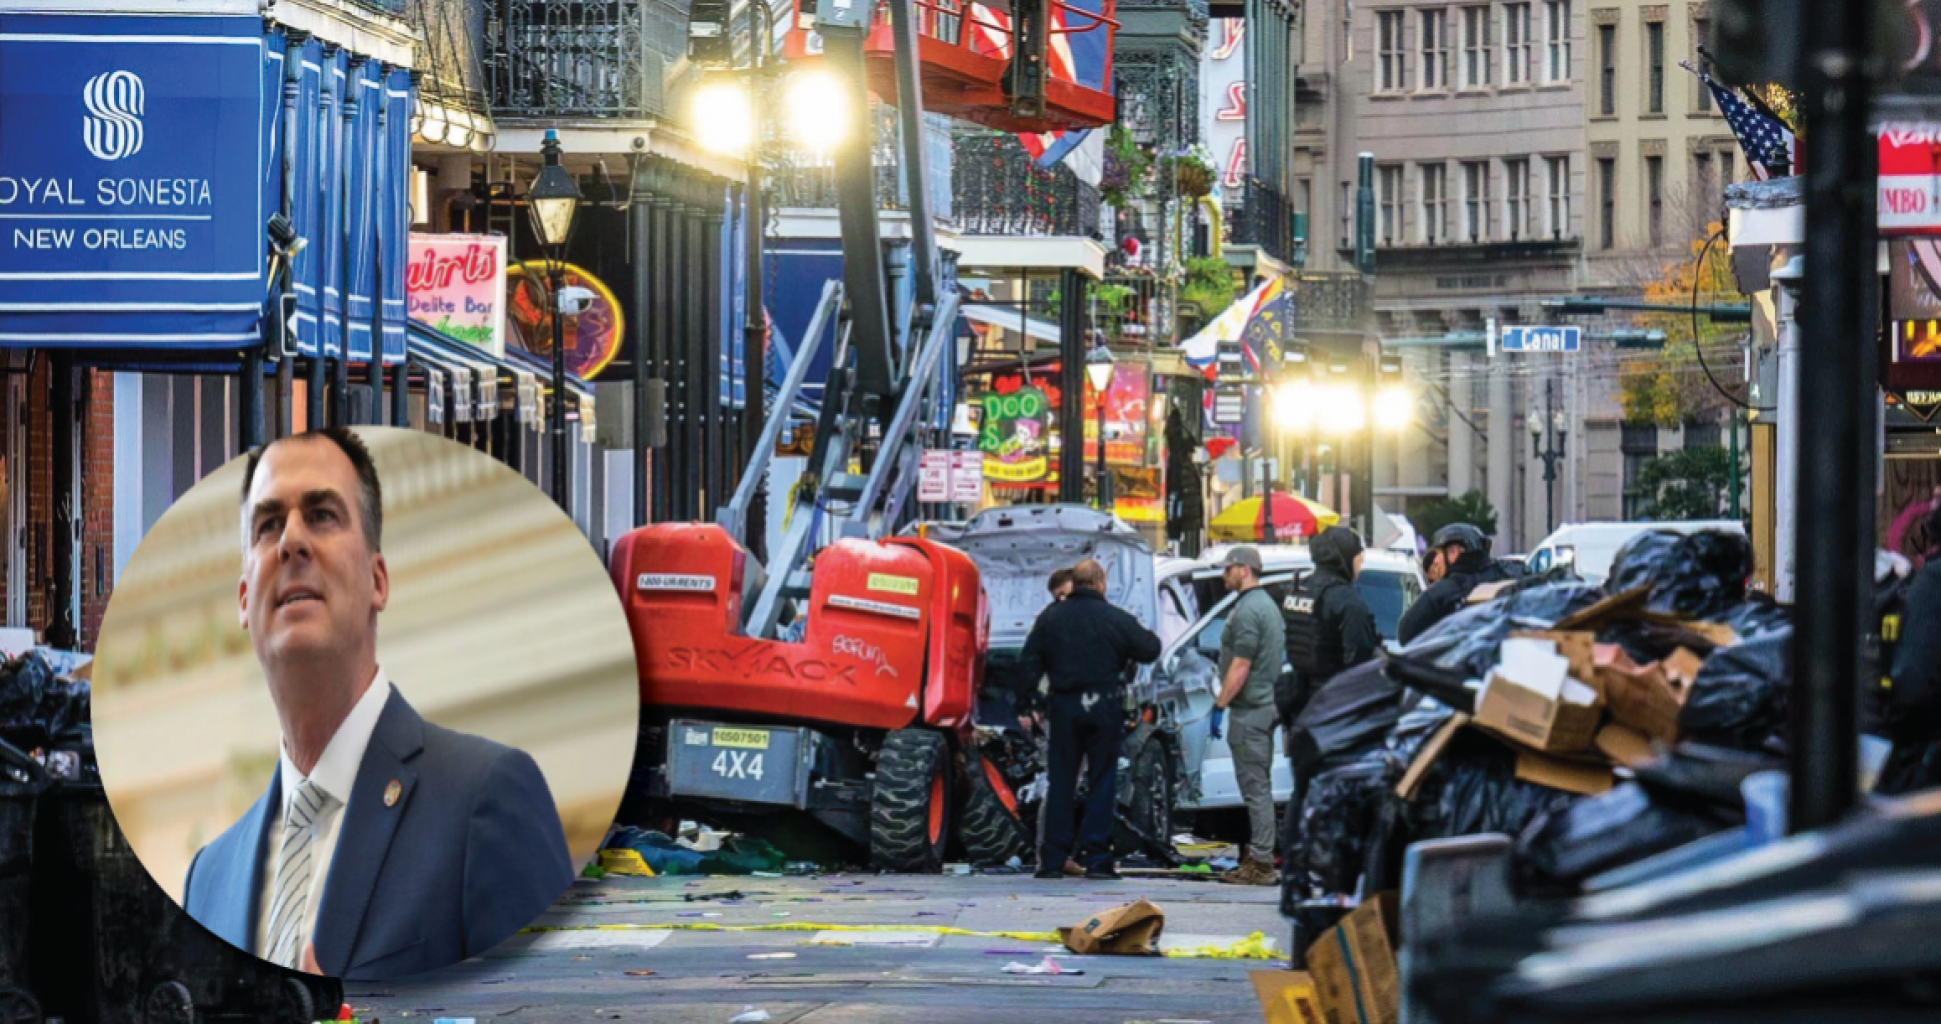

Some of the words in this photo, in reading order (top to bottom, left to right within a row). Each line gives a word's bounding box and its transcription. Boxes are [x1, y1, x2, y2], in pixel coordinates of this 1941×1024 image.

[0, 178, 85, 205] OYAL
[96, 178, 212, 206] SONESTA
[13, 229, 75, 250] NEW
[83, 229, 187, 250] ORLEANS
[409, 295, 455, 313] Delite
[465, 295, 493, 314] Bar
[1522, 328, 1566, 351] Canal
[711, 750, 764, 781] 4X4
